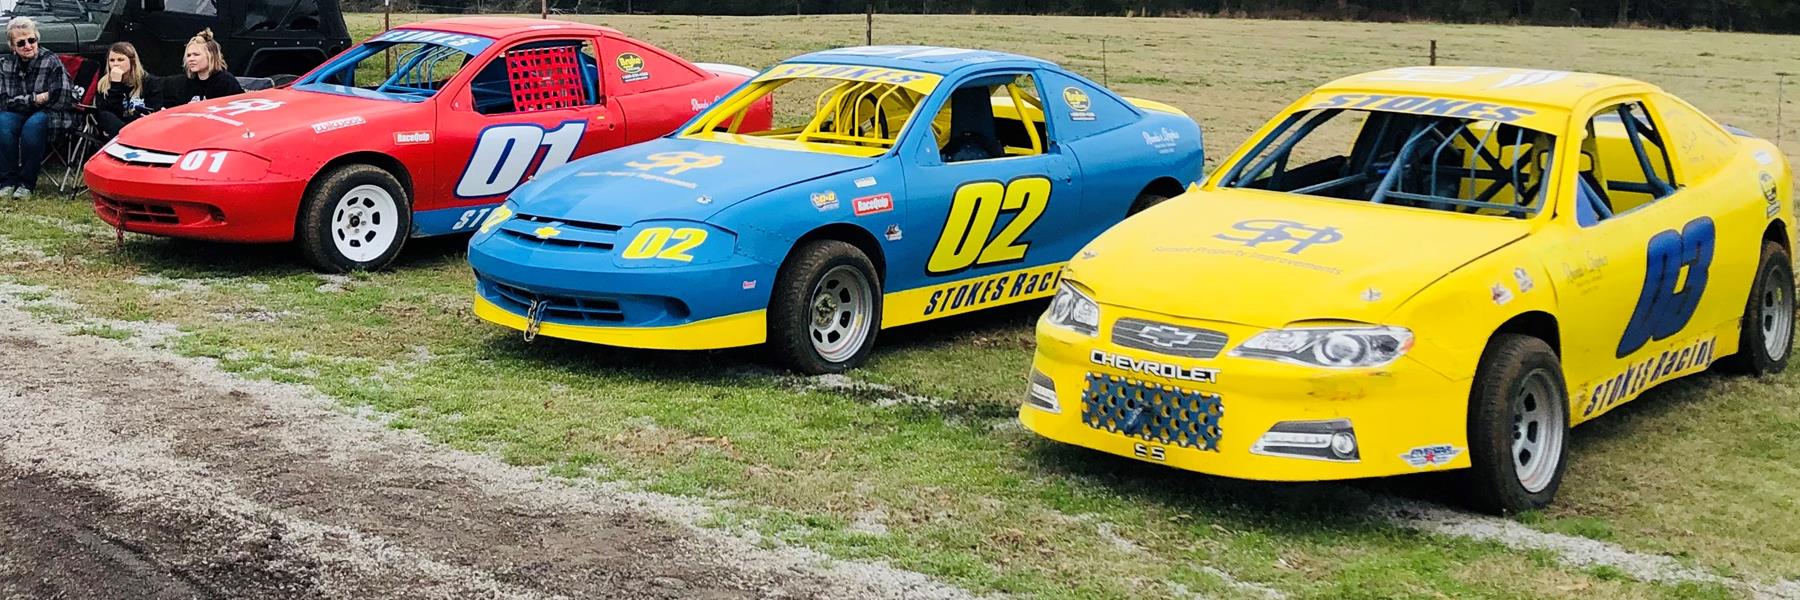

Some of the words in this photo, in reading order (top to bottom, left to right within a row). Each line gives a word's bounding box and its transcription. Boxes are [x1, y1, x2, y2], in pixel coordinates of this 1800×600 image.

[374, 29, 481, 46] STOKES
[773, 65, 924, 84] STOKES
[1311, 93, 1537, 122] STOKES
[180, 150, 228, 173] 01
[453, 121, 589, 199] 01
[857, 196, 890, 212] RaceQuip
[925, 174, 1052, 277] 02
[621, 227, 708, 262] 02
[1249, 251, 1343, 275] Improvements
[923, 277, 1019, 315] STOKES
[1009, 265, 1062, 297] Raci
[1615, 216, 1716, 359] 03
[1090, 349, 1221, 383] CHEVROLET
[1583, 357, 1654, 417] STOKES
[1649, 335, 1717, 382] Racing
